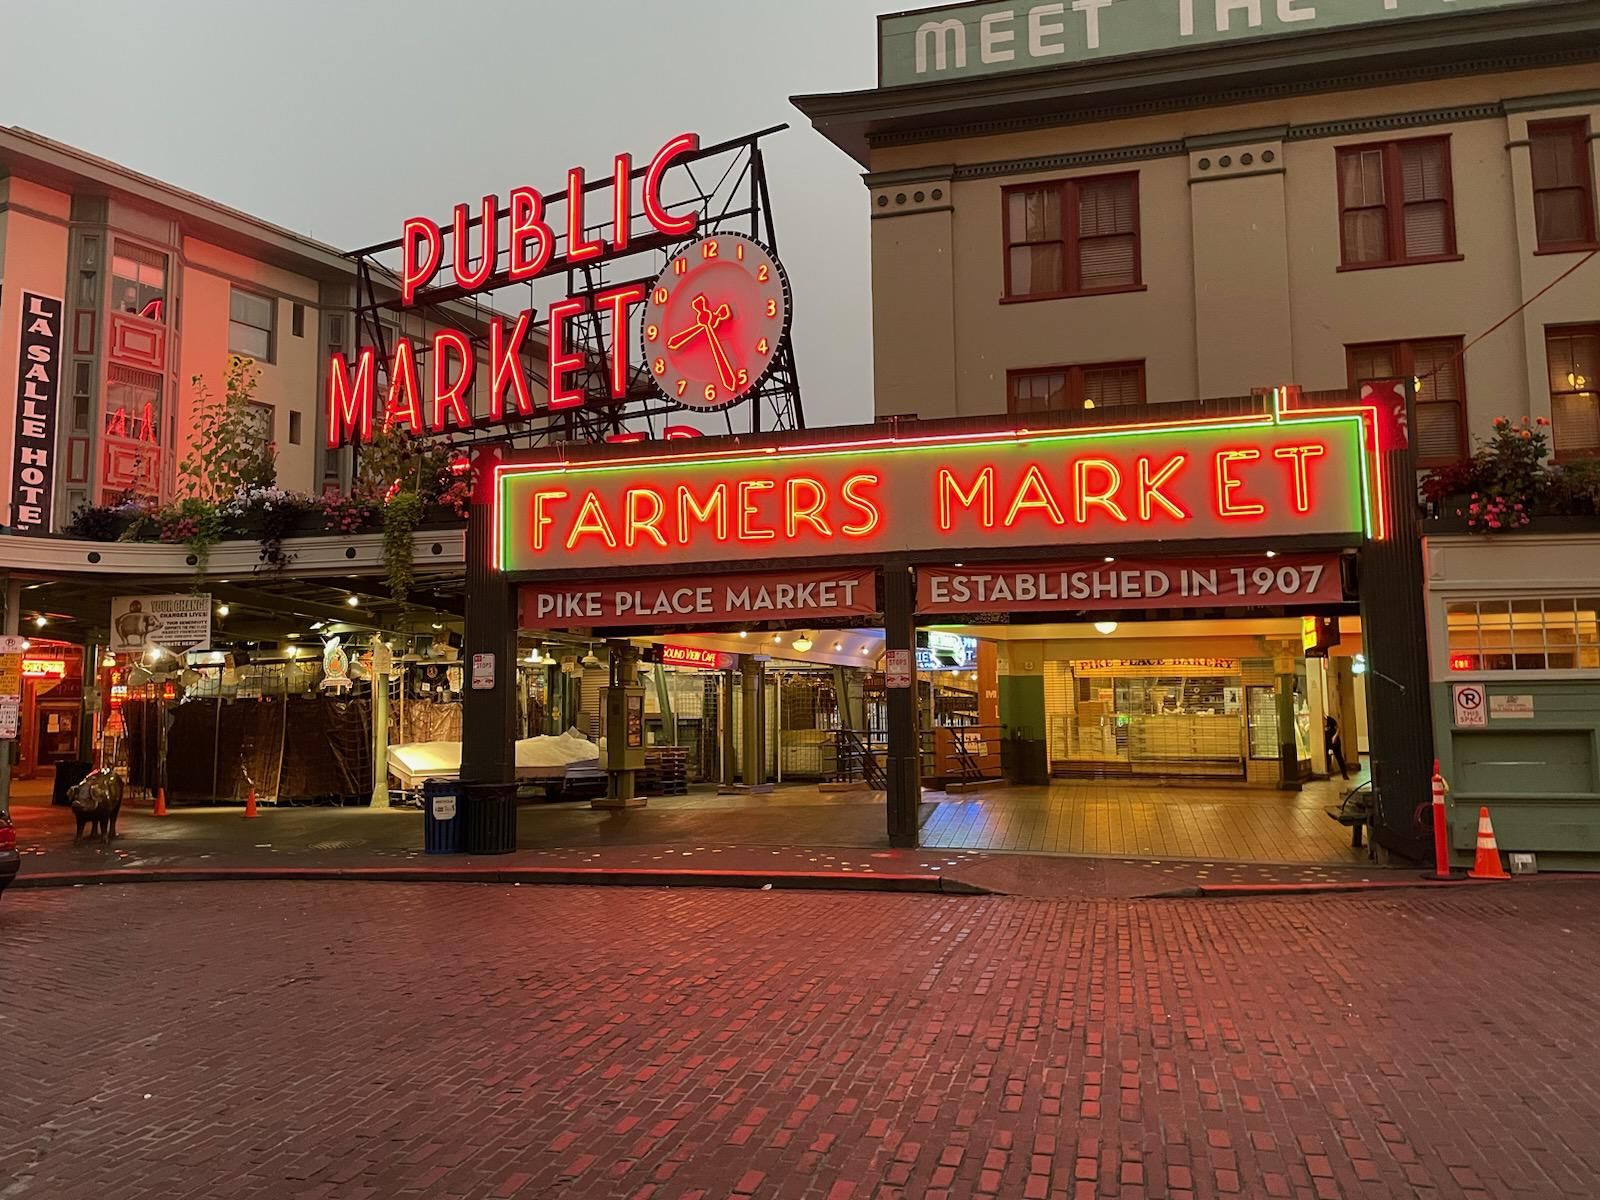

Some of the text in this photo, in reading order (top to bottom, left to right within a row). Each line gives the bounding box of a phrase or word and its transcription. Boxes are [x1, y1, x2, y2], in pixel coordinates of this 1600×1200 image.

[915, 0, 1112, 73] MEET
[401, 132, 700, 306] PUBLIC
[702, 240, 719, 258] 12
[737, 244, 744, 260] 1
[674, 258, 687, 275] 11
[757, 264, 769, 282] 2
[654, 288, 668, 305] 10
[27, 296, 54, 338] LA
[766, 299, 777, 317] 3
[647, 325, 658, 341] 9
[757, 338, 769, 355] 4
[327, 283, 648, 449] MARKET
[654, 358, 665, 375] 8
[737, 369, 748, 386] 5
[21, 344, 52, 440] SALLE
[676, 379, 687, 396] 7
[704, 384, 716, 401] 6
[532, 444, 1325, 550] FARMERS MARKET
[930, 564, 1325, 603] ESTABLISHED IN 1907
[537, 579, 860, 619] PIKE PLACE MARKET
[1080, 660, 1114, 670] PIKE
[1172, 658, 1234, 668] BAKERY
